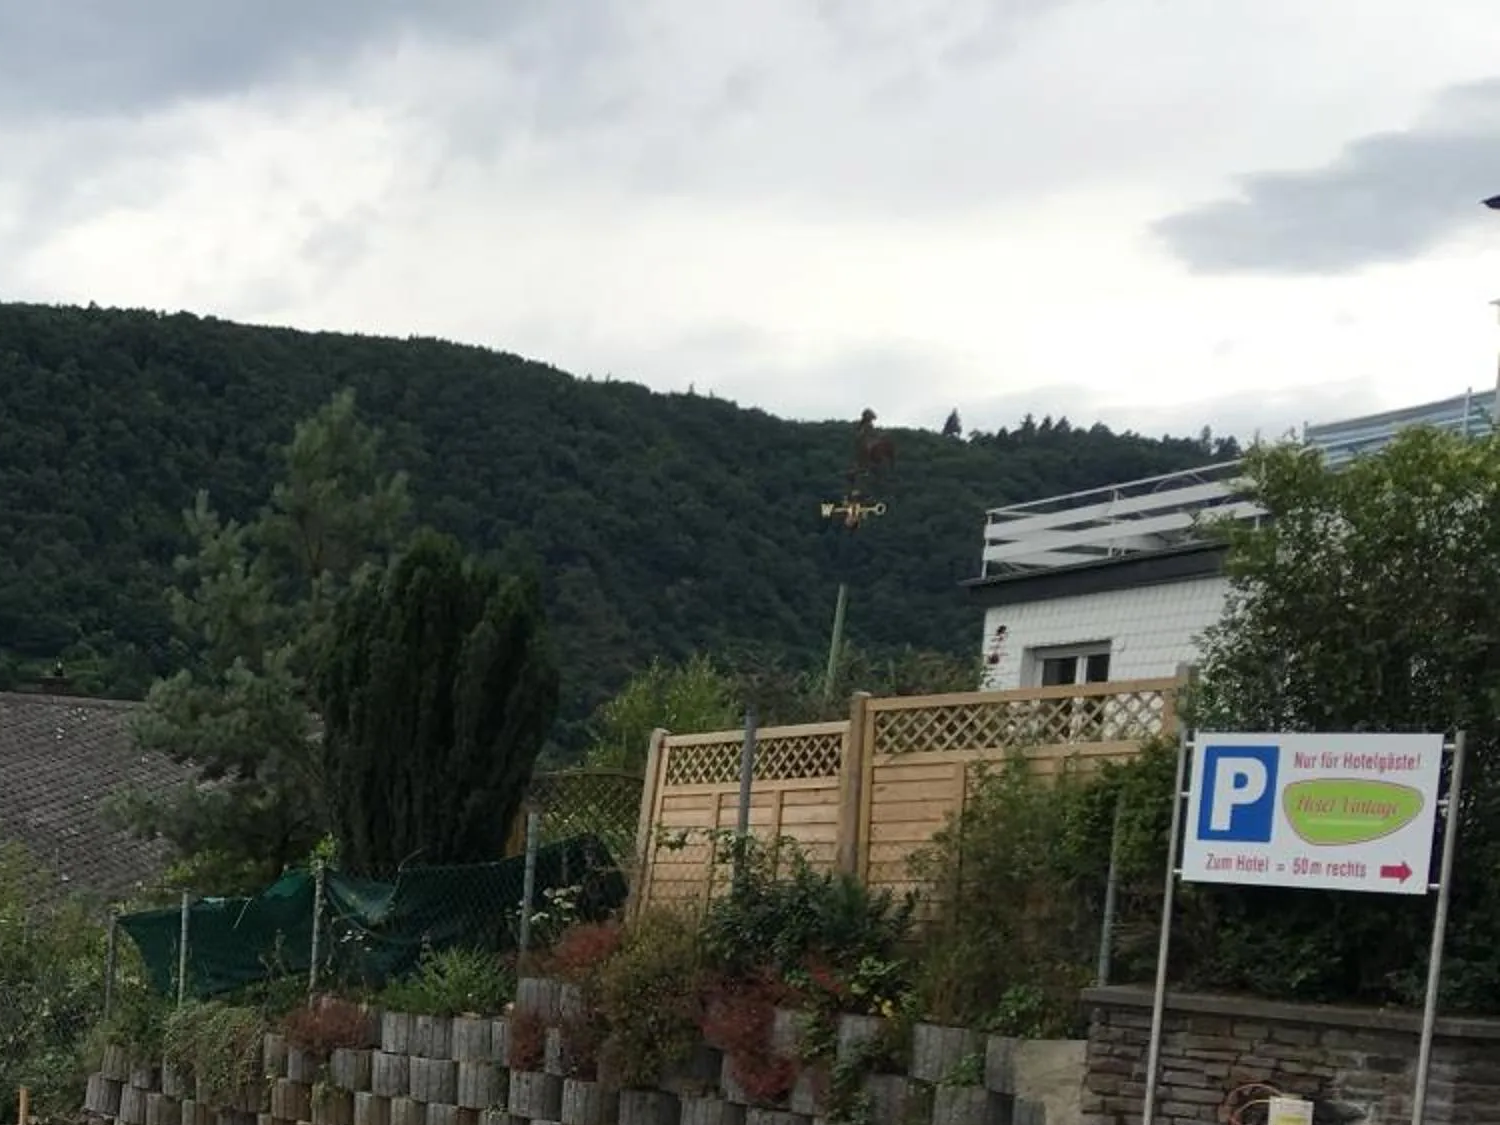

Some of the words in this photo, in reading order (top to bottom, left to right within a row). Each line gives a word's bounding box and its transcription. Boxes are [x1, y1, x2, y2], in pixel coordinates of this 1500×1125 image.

[1294, 751, 1317, 769] Nur
[1320, 751, 1339, 769] für
[1343, 751, 1423, 773] Hotelgäste!
[1209, 756, 1268, 832] P
[1296, 794, 1337, 814] Hotel
[1205, 853, 1233, 871] Zum
[1236, 855, 1269, 873] Hotel
[1326, 860, 1367, 878] rechts
